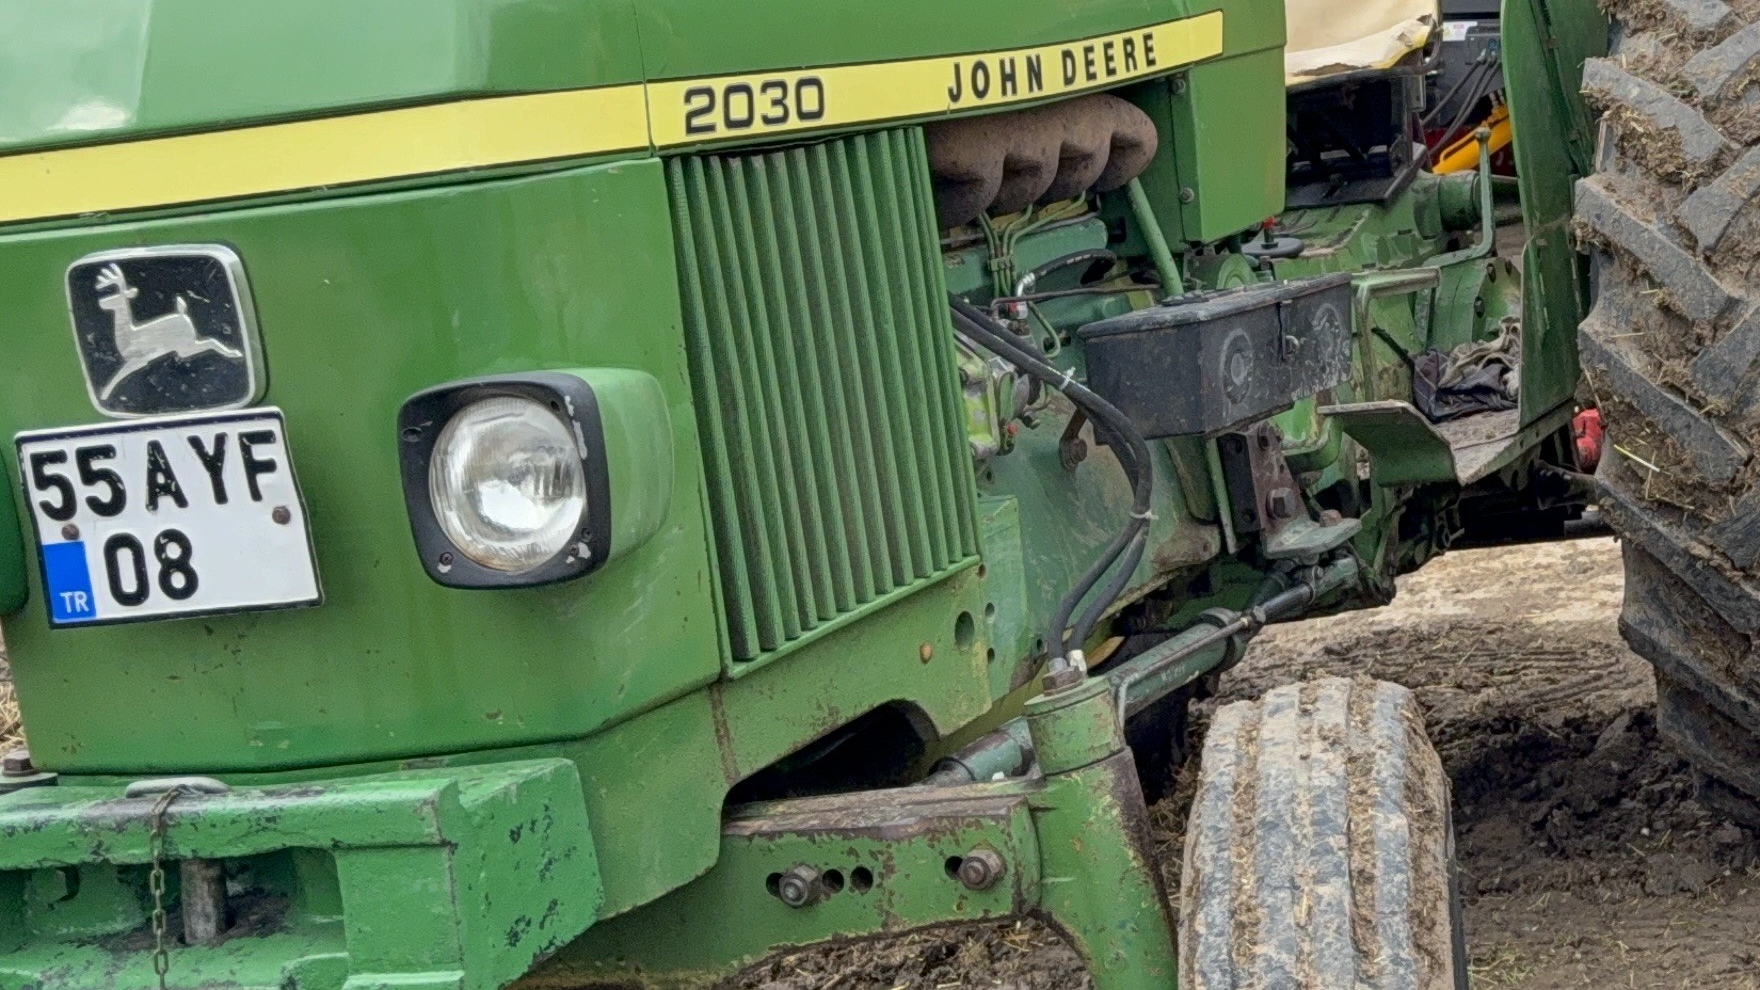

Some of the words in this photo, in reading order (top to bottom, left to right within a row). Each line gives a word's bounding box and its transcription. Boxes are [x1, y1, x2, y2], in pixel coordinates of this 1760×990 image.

[684, 76, 825, 136] 2030
[947, 54, 1043, 104] JOHN
[1061, 32, 1158, 88] DEERE
[30, 443, 127, 522] 55
[145, 430, 279, 513] AYF
[60, 591, 89, 614] TR
[104, 528, 199, 607] 08
